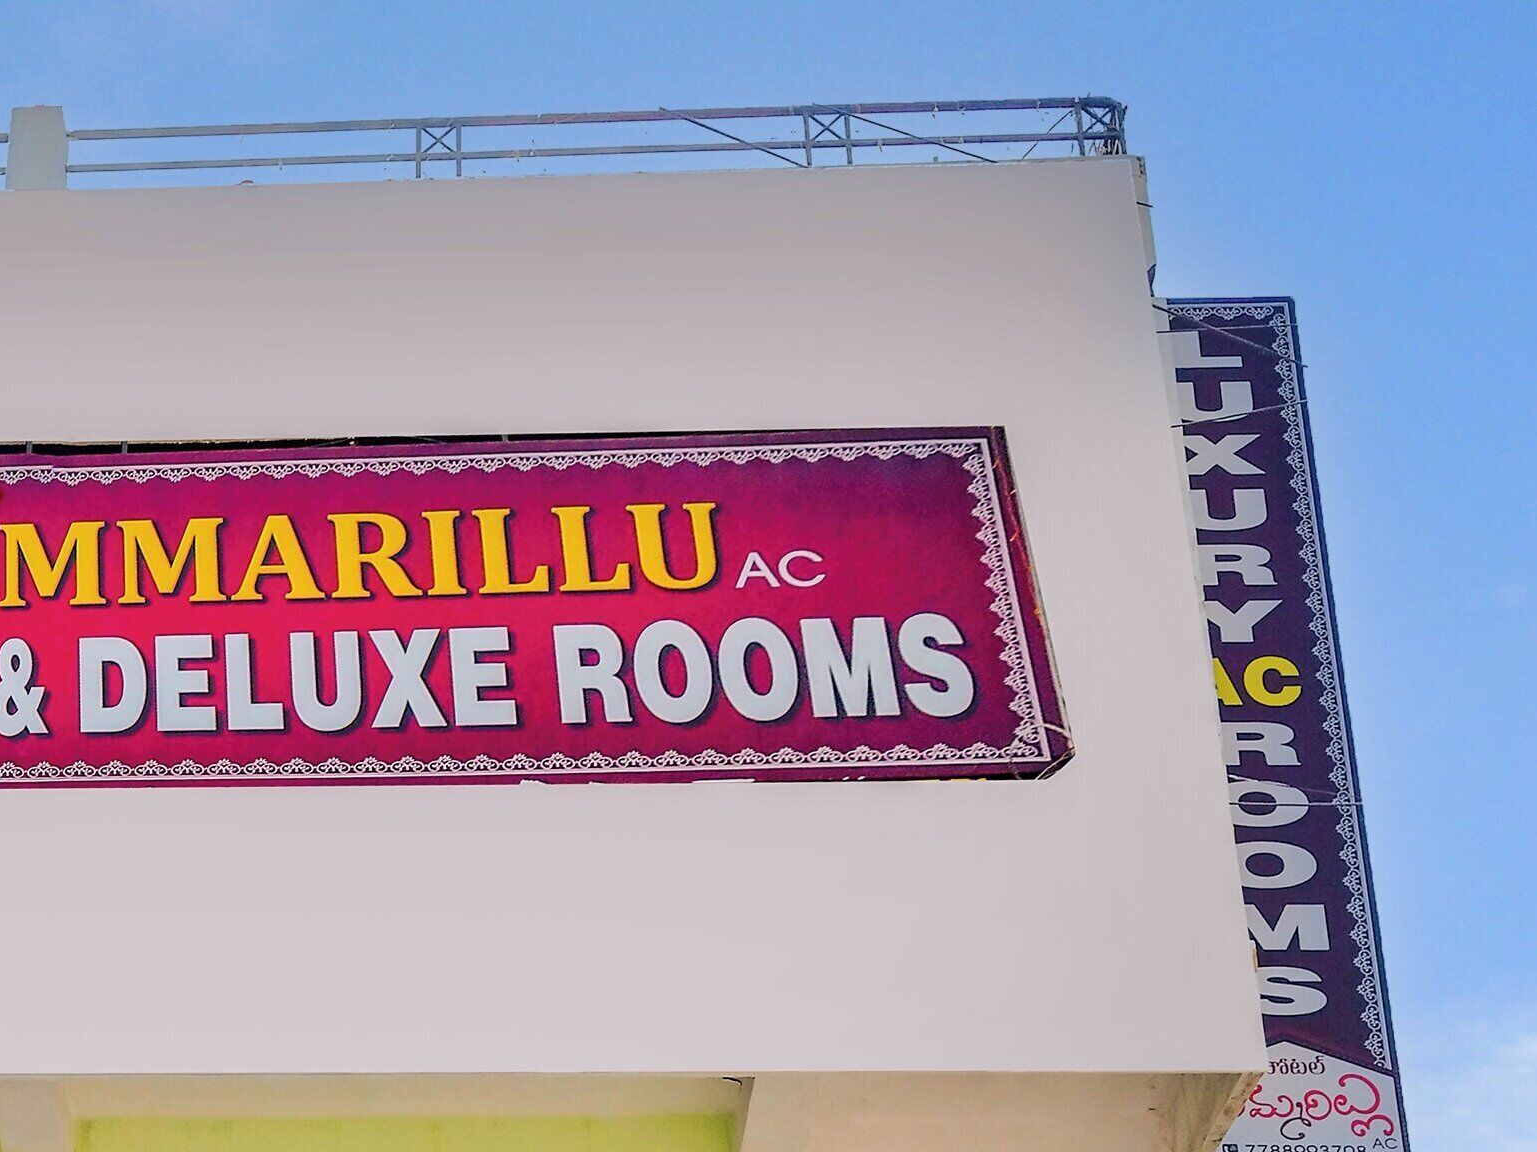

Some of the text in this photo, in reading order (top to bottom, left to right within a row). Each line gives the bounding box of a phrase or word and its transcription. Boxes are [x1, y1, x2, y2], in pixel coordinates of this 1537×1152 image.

[735, 551, 826, 589] AC
[79, 625, 518, 733] DELUXE
[552, 612, 976, 726] ROOMS
[1372, 1138, 1398, 1149] AC
